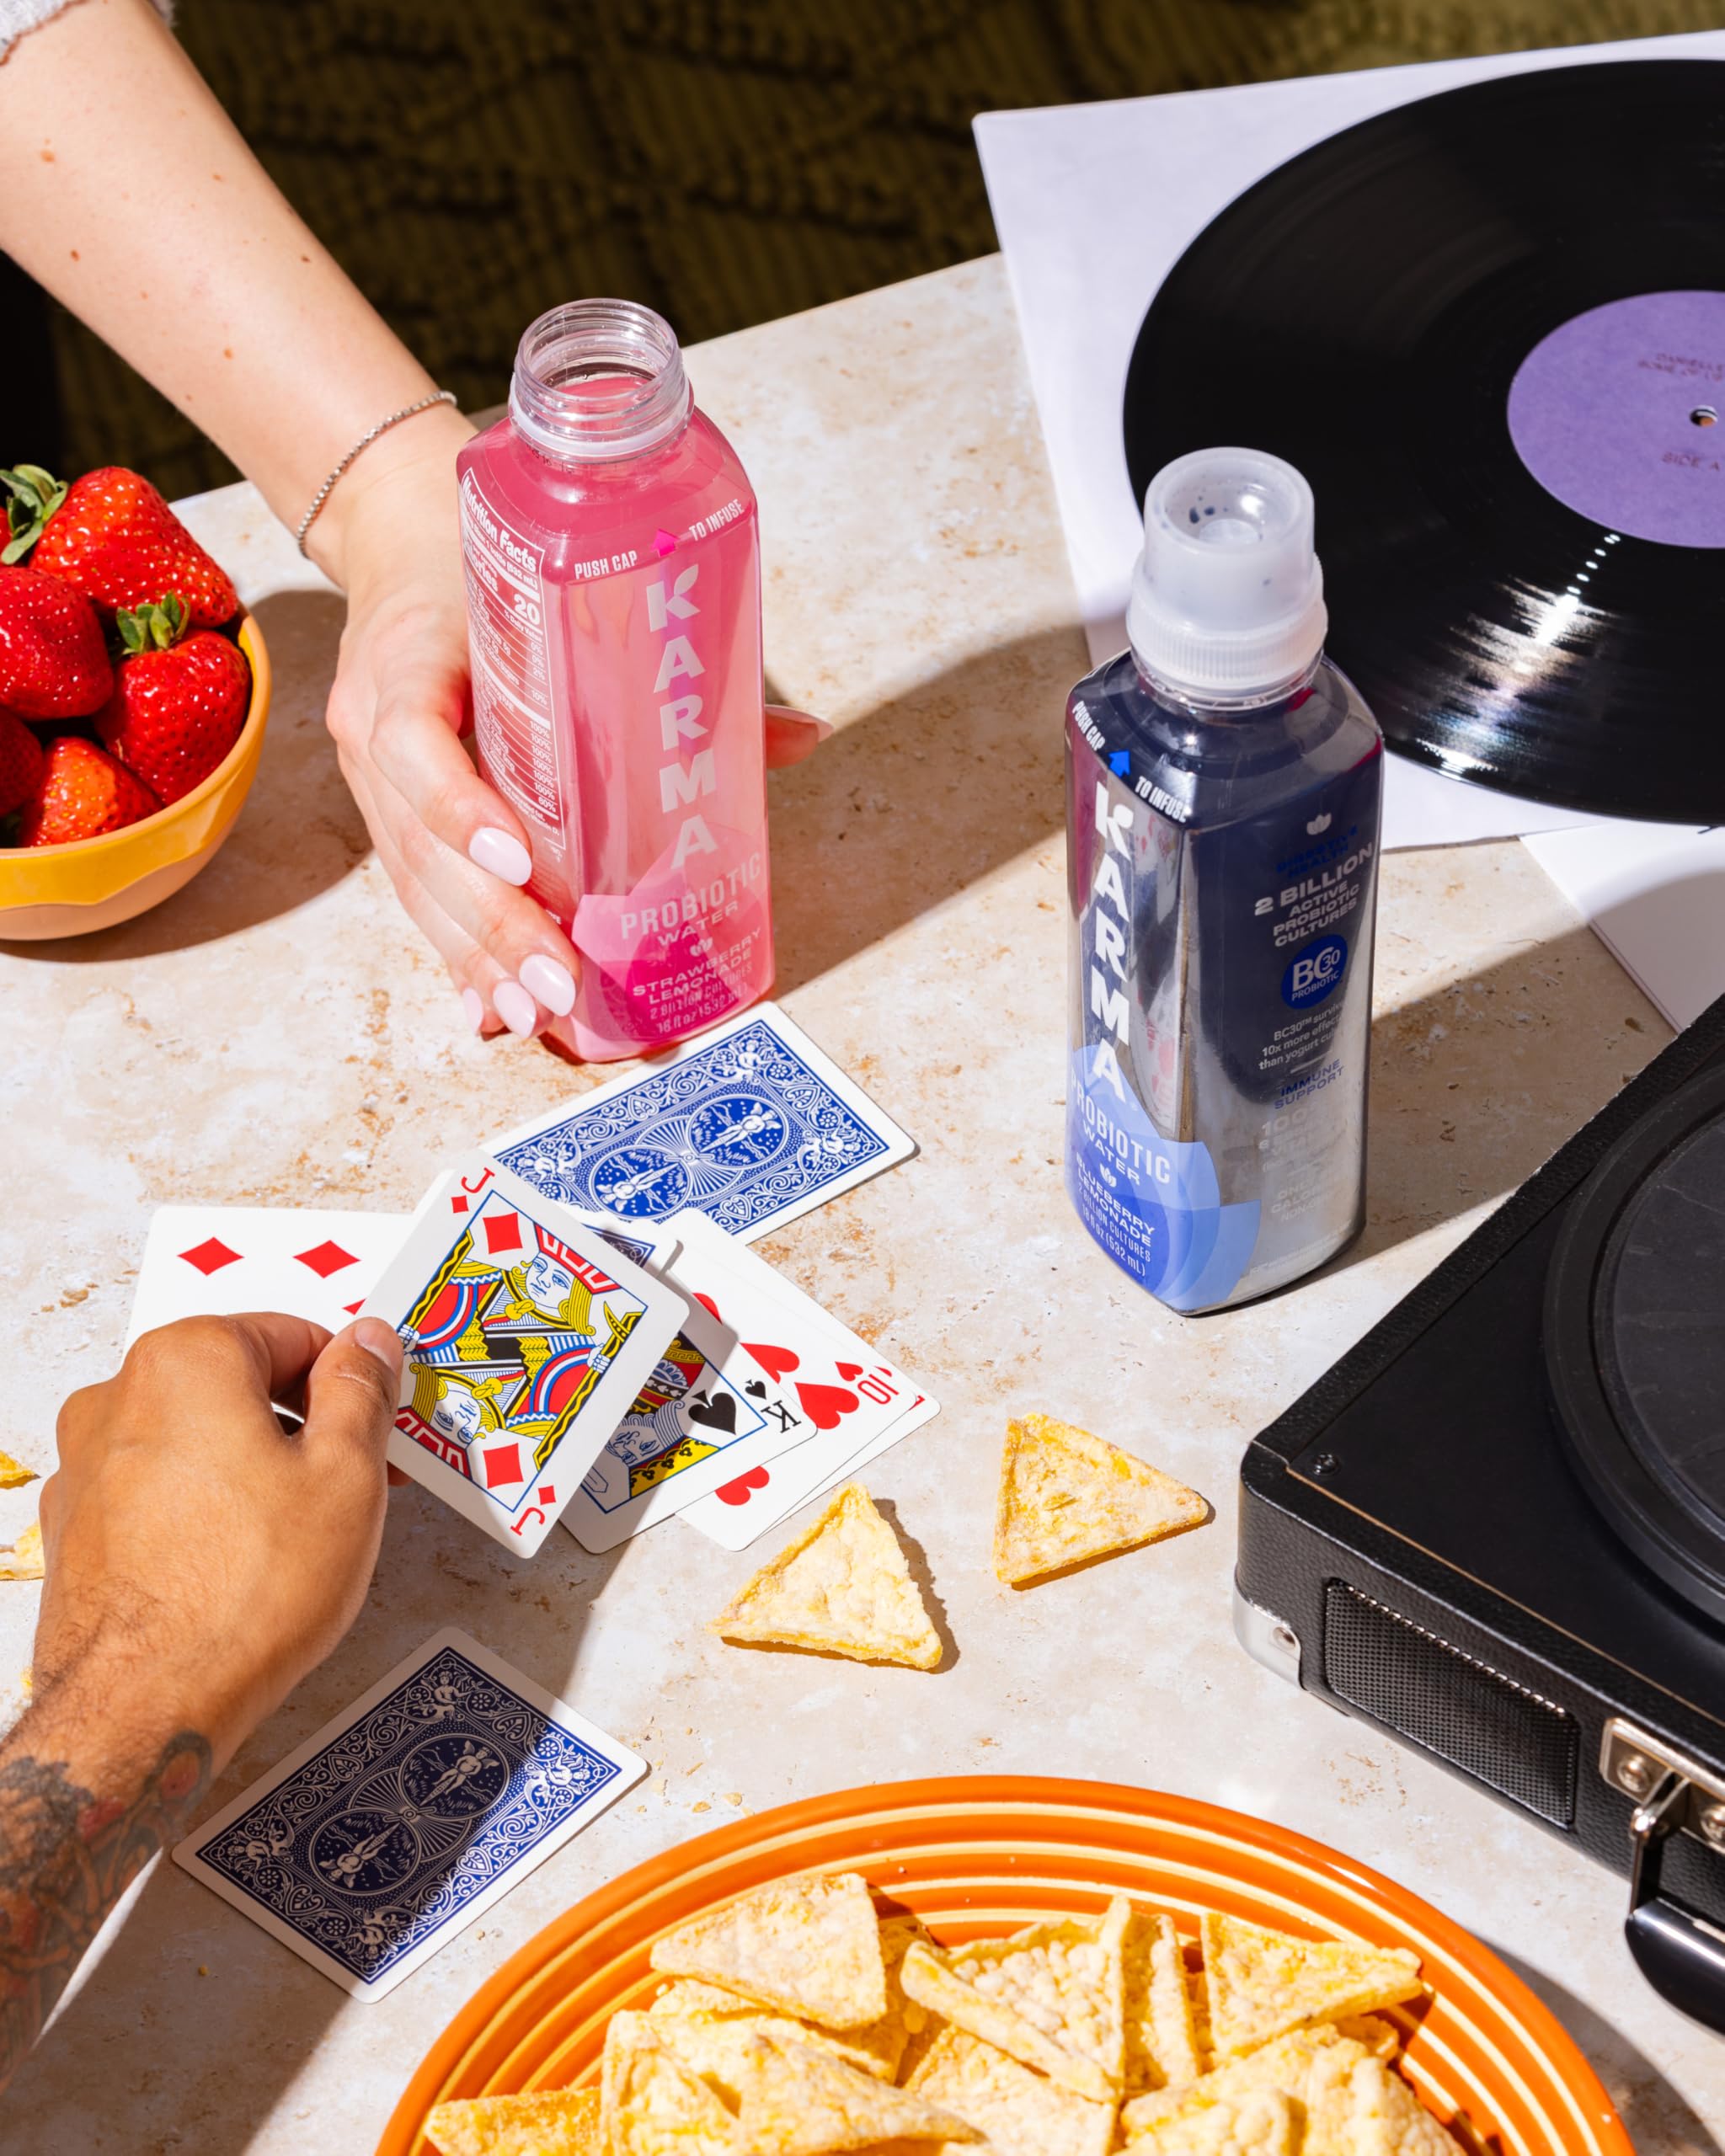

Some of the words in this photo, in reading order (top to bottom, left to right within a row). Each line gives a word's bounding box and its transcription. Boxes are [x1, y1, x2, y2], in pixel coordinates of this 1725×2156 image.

[462, 475, 498, 543] Nutrition
[499, 529, 537, 573] Facts
[689, 522, 705, 542] TO
[706, 499, 745, 532] INFUSE
[574, 561, 610, 580] PUSH
[613, 550, 638, 573] CAP
[514, 594, 541, 626] 20
[646, 563, 718, 870] KARMA
[1071, 701, 1093, 734] PUSH
[1084, 725, 1106, 751] CAP
[1135, 776, 1151, 798] TO
[1148, 786, 1187, 824] INFUSE
[620, 851, 763, 941] PROBIOTIC
[1254, 897, 1274, 916] 2
[1279, 842, 1373, 907] BILLION
[1289, 879, 1348, 918] ACTIVE
[656, 899, 740, 947] WATER
[1273, 883, 1361, 937] PROBIOTIC
[1274, 897, 1358, 947] CULTURES
[633, 926, 762, 996] STRAWBERRY
[1091, 781, 1135, 1103] KARMA
[648, 947, 752, 1005] LEMONADE
[1290, 970, 1340, 1002] PROBIOTIC
[649, 1007, 658, 1021] 2
[1258, 1054, 1284, 1070] than
[1285, 1037, 1319, 1063] yogurt
[1262, 1044, 1282, 1057] 10x
[1283, 1031, 1311, 1049] more
[1274, 1066, 1346, 1110] SUPPORT
[1280, 1059, 1342, 1097] IMMUNE
[1071, 1063, 1171, 1184] PROBIOTIC
[1083, 1119, 1140, 1186] WATER
[461, 1167, 495, 1194] J
[1076, 1151, 1155, 1235] BLUEBERRY
[1078, 1166, 1151, 1247] LEMONADE
[1083, 1189, 1108, 1227] BILLION
[1109, 1221, 1151, 1262] CULTURES
[1096, 1225, 1104, 1241] oz
[1106, 1232, 1126, 1262] (532
[1127, 1254, 1146, 1277] mL)
[857, 1374, 900, 1405] 10
[761, 1400, 802, 1434] K
[510, 1507, 545, 1537] J
